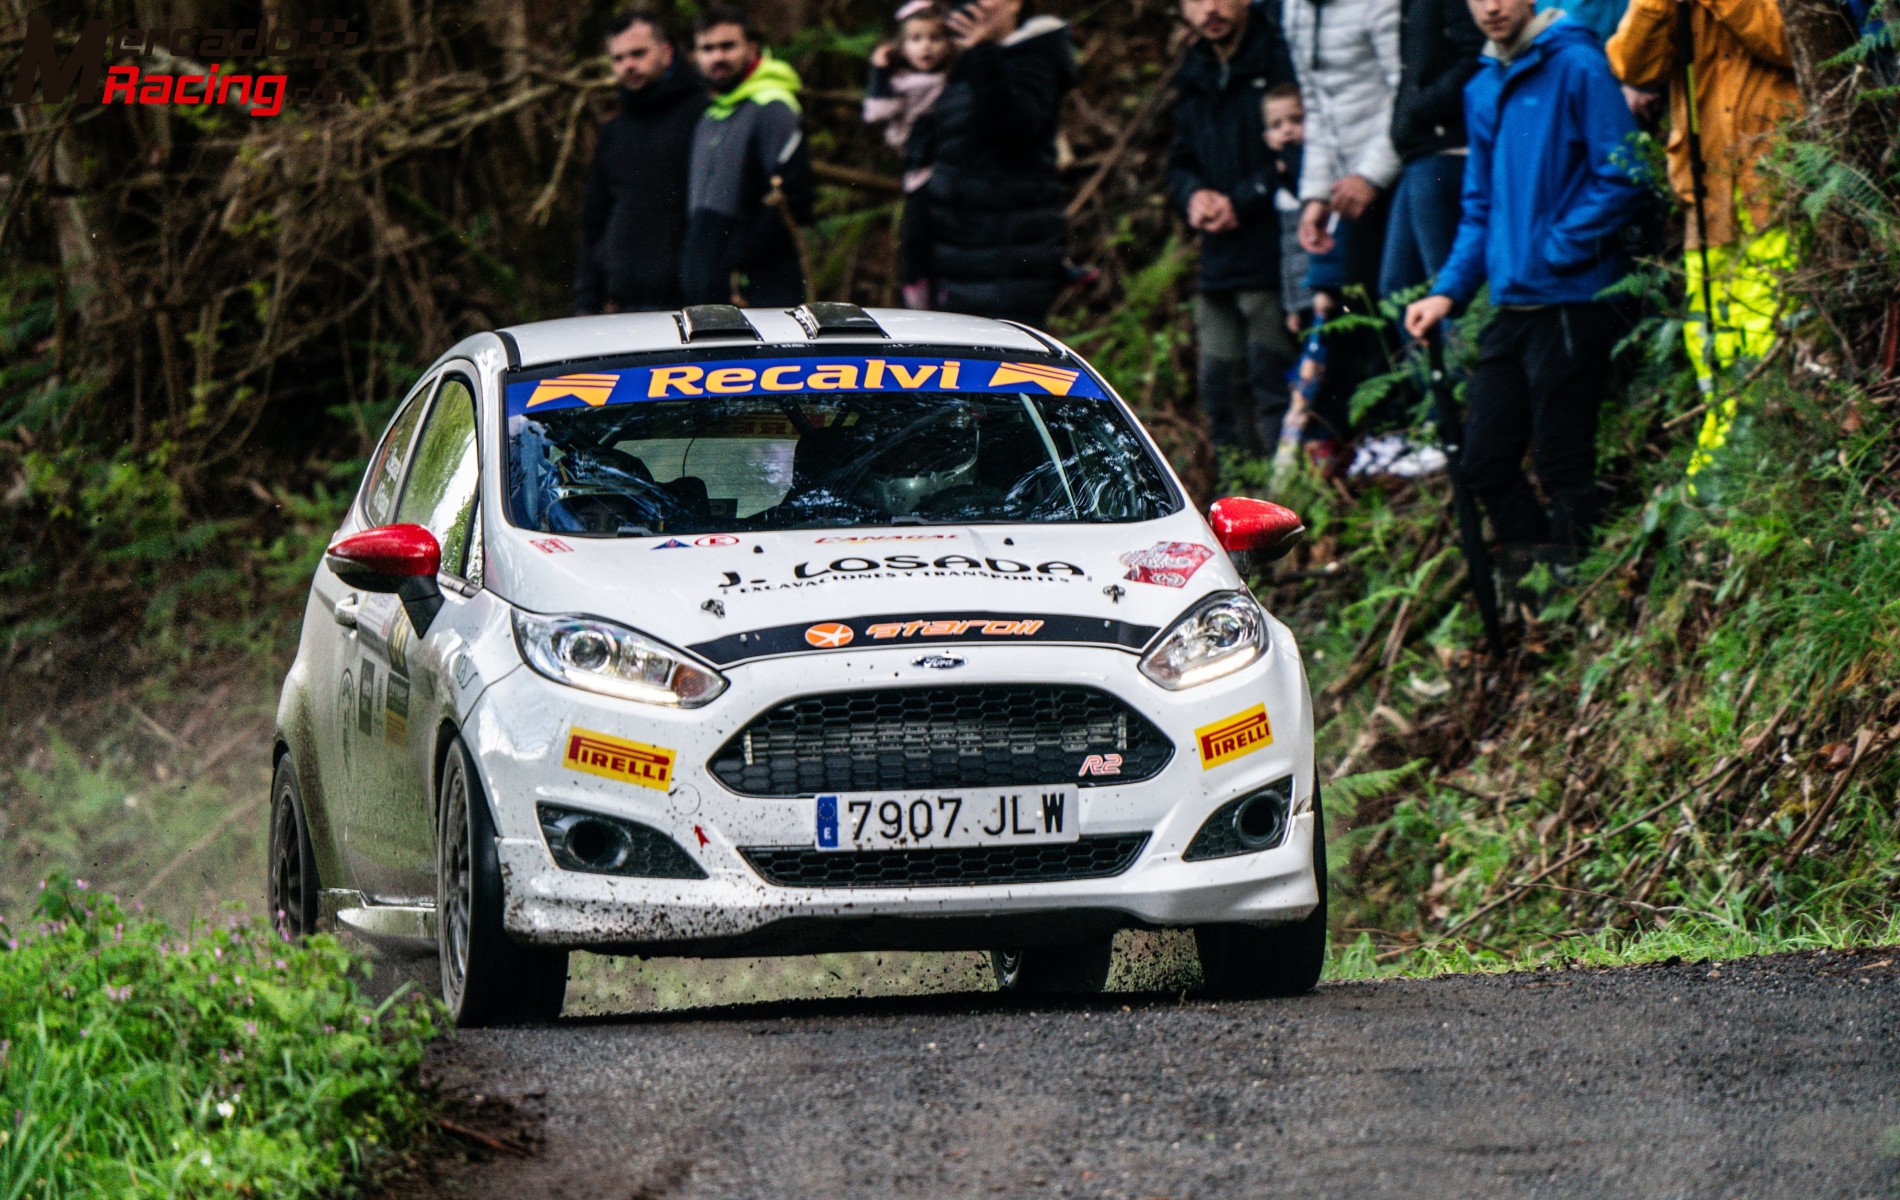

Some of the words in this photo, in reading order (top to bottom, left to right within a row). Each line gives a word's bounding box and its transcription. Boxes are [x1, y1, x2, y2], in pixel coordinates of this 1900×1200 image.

[647, 359, 961, 399] Recalvi
[794, 555, 1085, 580] LOSADA
[740, 572, 896, 593] EXCAVACIONES
[923, 571, 1070, 583] TRANSPORTES
[865, 619, 1045, 639] staroil
[1200, 711, 1270, 761] PIRELLI
[568, 735, 670, 782] PIRELLI
[1078, 753, 1123, 777] R2
[848, 799, 963, 841] 7907
[983, 793, 1065, 836] JLW
[823, 827, 832, 840] E
